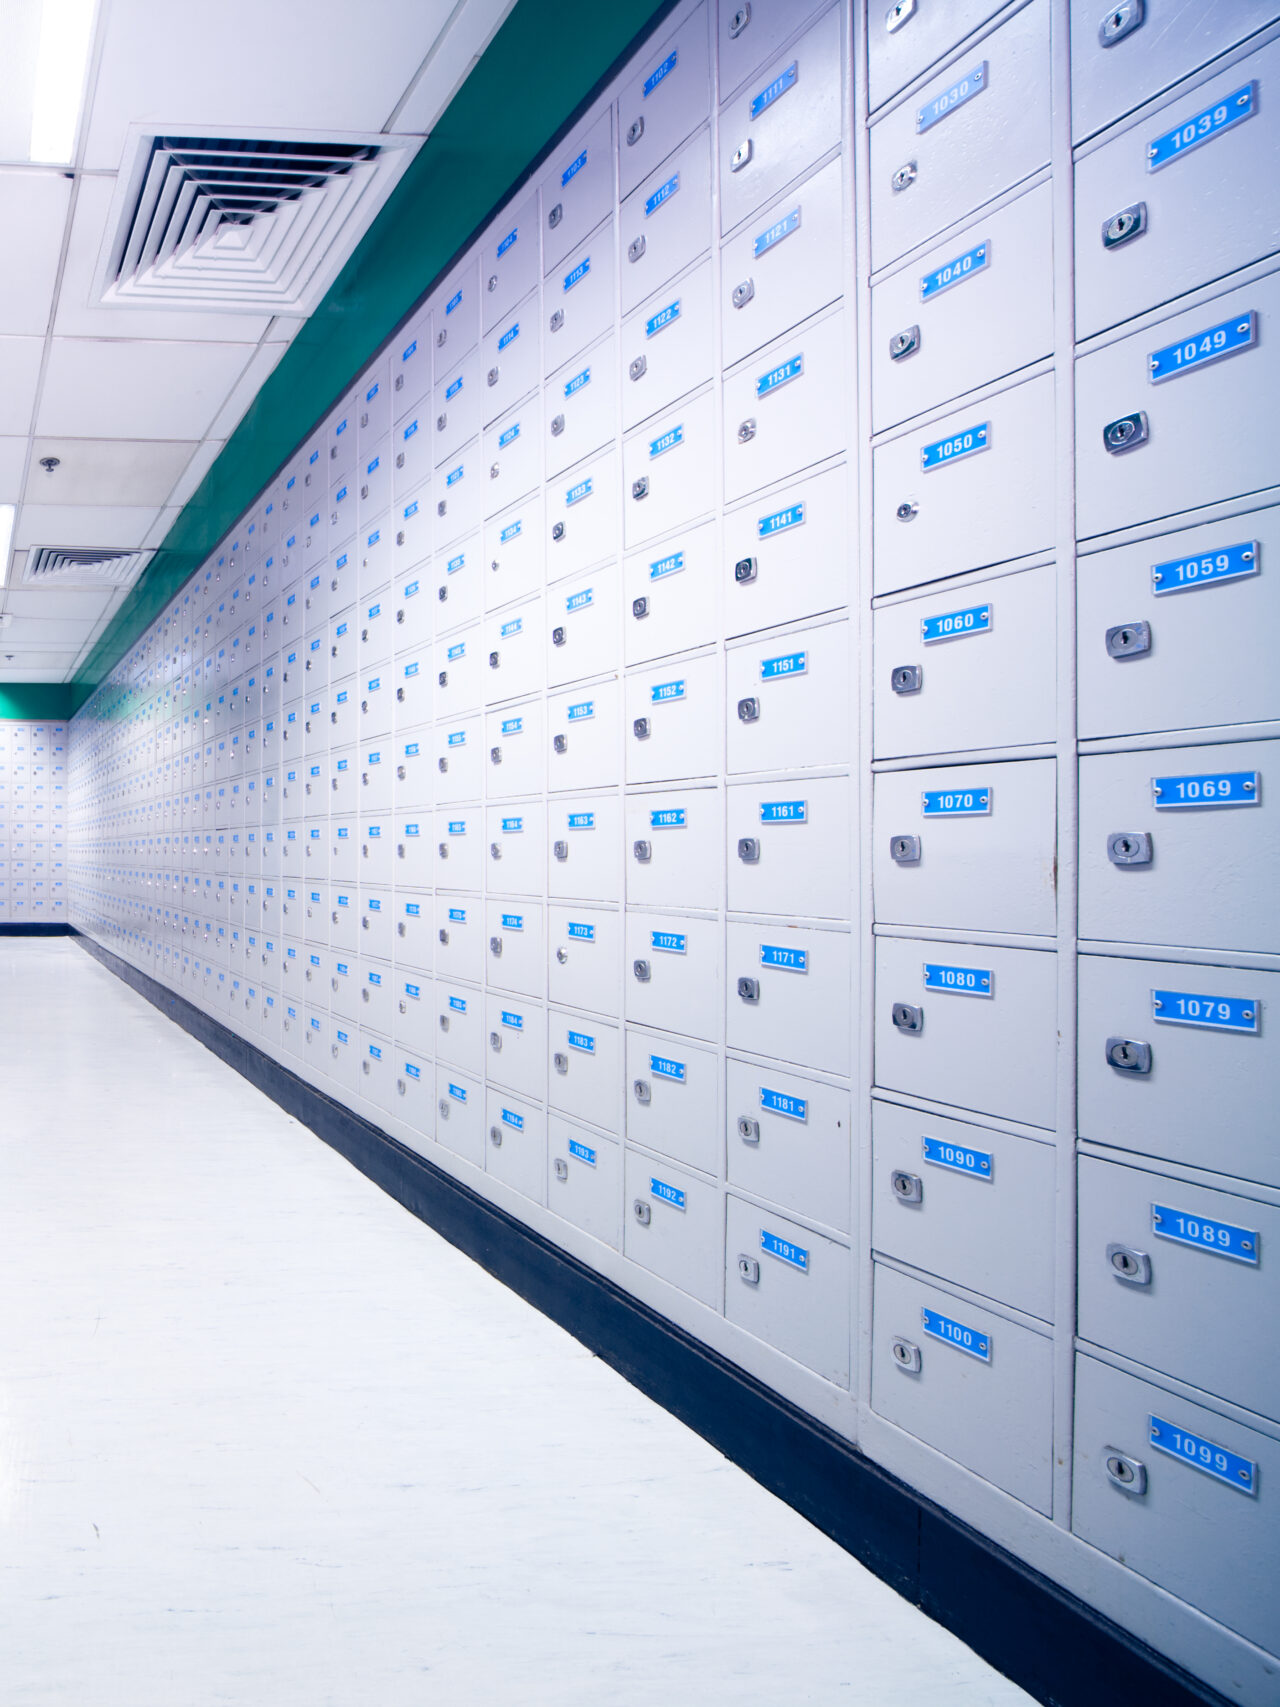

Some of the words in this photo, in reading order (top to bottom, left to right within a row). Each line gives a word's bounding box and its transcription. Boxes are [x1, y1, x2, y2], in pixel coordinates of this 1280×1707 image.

[652, 61, 668, 88] 1102
[763, 74, 785, 106] 1111
[933, 79, 968, 120] 1030
[1172, 103, 1227, 151] 1039
[653, 182, 670, 207] 1112
[766, 218, 787, 245] 1121
[936, 254, 972, 288] 1040
[653, 307, 672, 330] 1122
[1175, 329, 1226, 366] 1049
[768, 363, 790, 387] 1131
[657, 432, 675, 451] 1132
[937, 433, 972, 460] 1050
[770, 511, 792, 530] 1141
[658, 557, 675, 574] 1142
[1177, 554, 1229, 582] 1059
[937, 613, 974, 634] 1060
[773, 658, 794, 673] 1151
[659, 684, 676, 698] 1152
[574, 705, 587, 717] 1153
[1178, 779, 1231, 798] 1069
[772, 805, 793, 817] 1161
[939, 794, 973, 809] 1070
[659, 812, 677, 823] 1162
[574, 925, 588, 936] 1173
[660, 935, 677, 947] 1172
[773, 950, 794, 964] 1171
[940, 970, 975, 987] 1080
[1178, 999, 1230, 1020] 1079
[574, 1035, 588, 1047] 1183
[658, 1060, 676, 1075] 1182
[773, 1095, 793, 1112] 1181
[575, 1144, 589, 1159] 1193
[939, 1145, 975, 1168] 1090
[659, 1184, 676, 1201] 1192
[1179, 1217, 1230, 1248] 1089
[774, 1239, 795, 1260] 1191
[940, 1320, 972, 1347] 1100
[1176, 1433, 1227, 1473] 1099
